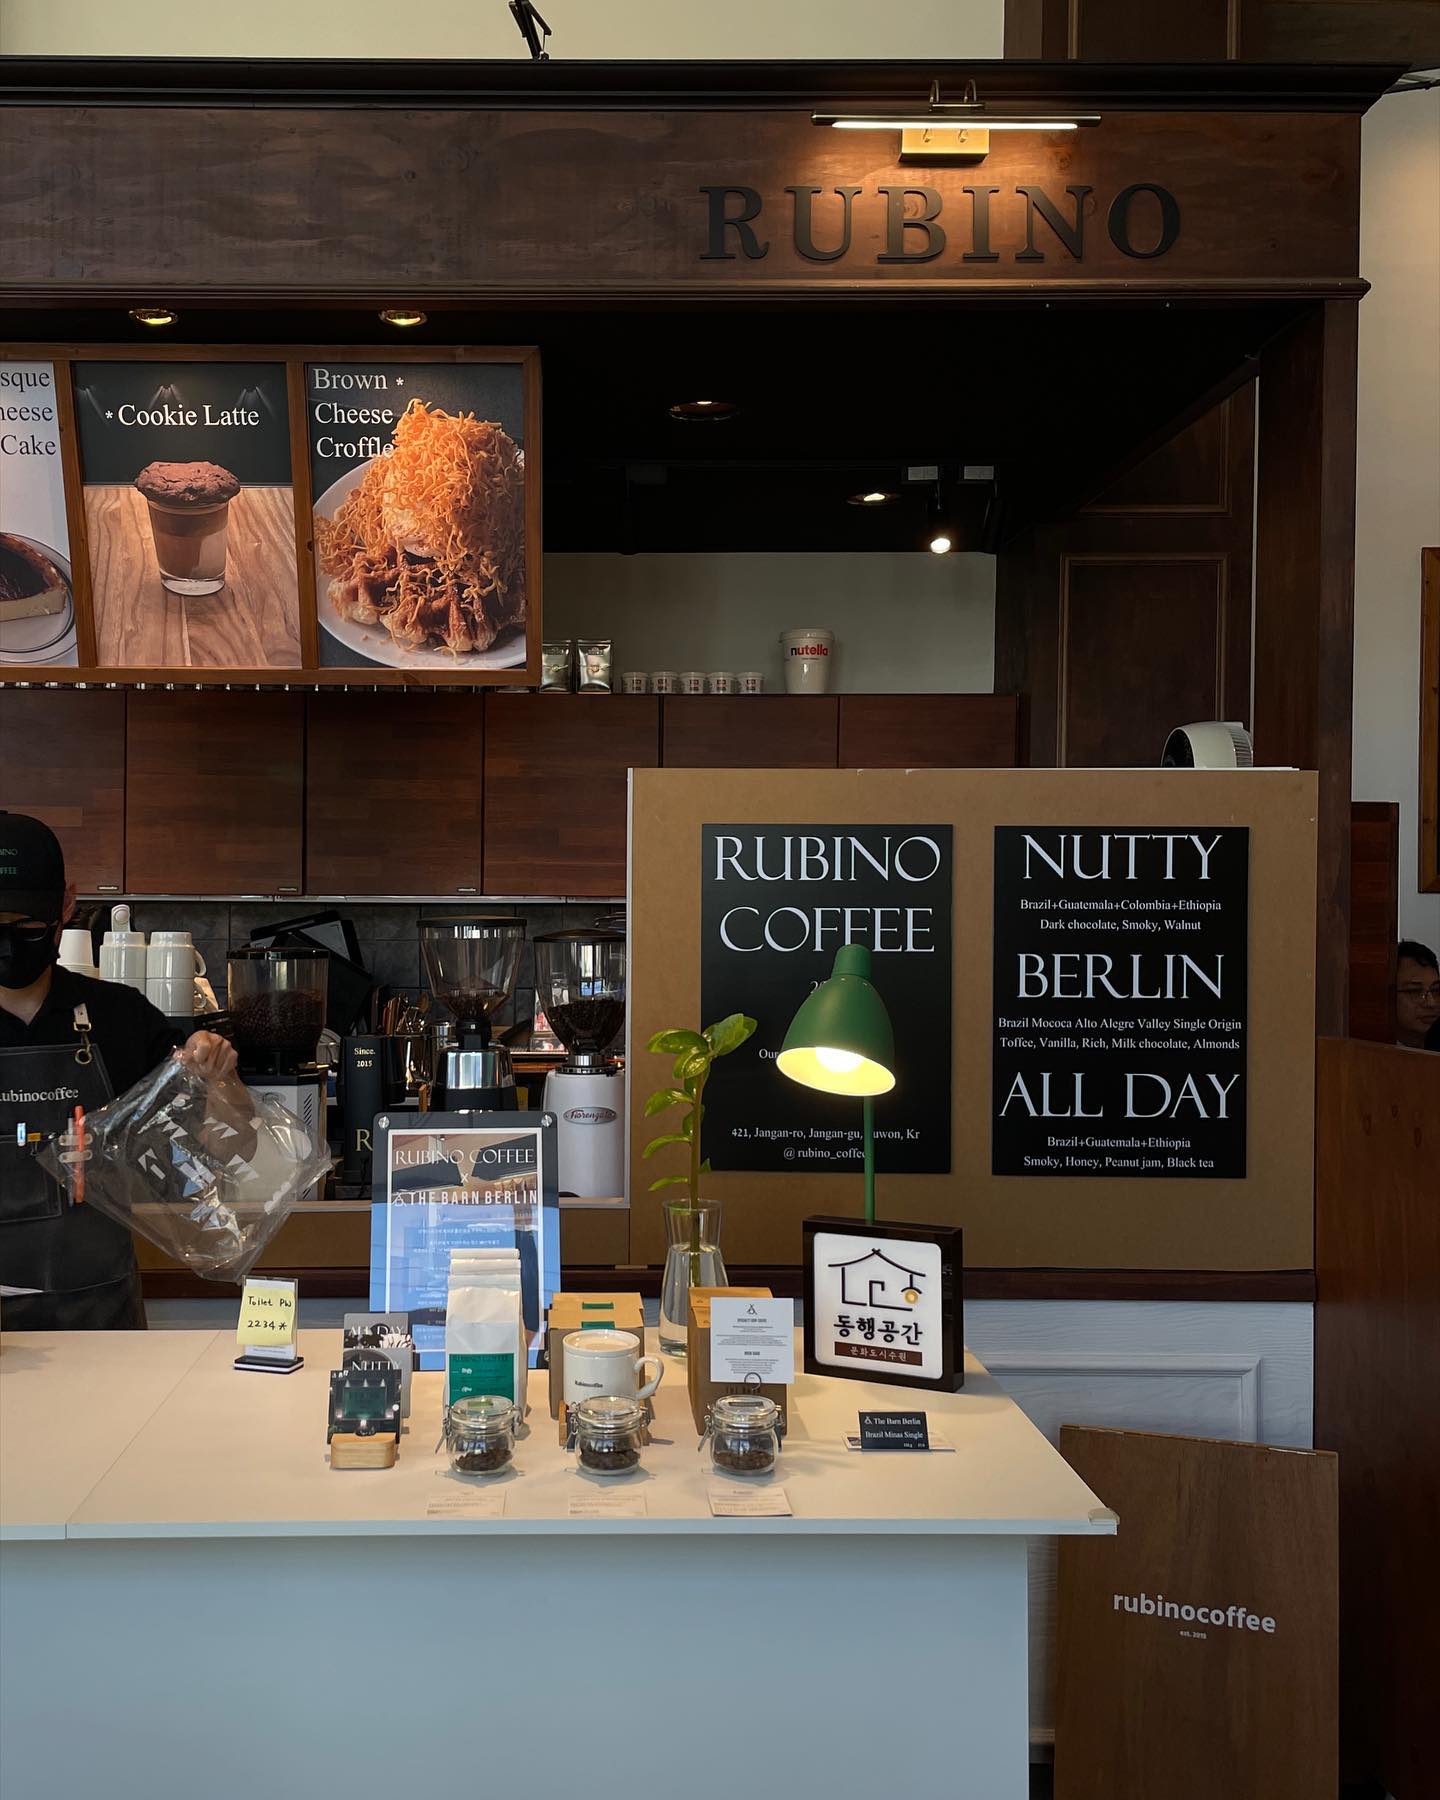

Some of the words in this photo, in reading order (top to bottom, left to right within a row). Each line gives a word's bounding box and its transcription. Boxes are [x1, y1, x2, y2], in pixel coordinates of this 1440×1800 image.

[699, 182, 1181, 263] RUBINO
[0, 370, 50, 393] sque
[313, 368, 388, 389] Brown
[118, 404, 198, 426] Cookie
[203, 405, 260, 426] Latte
[315, 402, 394, 424] Cheese
[1, 435, 57, 455] Cake
[316, 436, 394, 458] Croffle
[790, 643, 829, 656] nutella
[714, 835, 941, 882] RUBINO
[1021, 834, 1223, 880] NUTTY
[1020, 899, 1222, 913] Brazil+Guatemala+Colombia+Ethiopia
[720, 906, 936, 952] COFFEE
[1040, 919, 1065, 930] Dark
[1067, 919, 1119, 931] chocolate,
[1122, 919, 1161, 932] Smoky,
[1164, 919, 1201, 930] Walnut
[1017, 953, 1224, 999] BERLIN
[998, 1017, 1029, 1028] Brazil
[1031, 1017, 1072, 1028] Mococa
[1075, 1018, 1098, 1029] Alto
[1100, 1018, 1135, 1031] Alegre
[1137, 1018, 1171, 1031] Valley
[1173, 1018, 1206, 1031] Single
[1208, 1018, 1242, 1032] Origin
[1000, 1037, 1036, 1049] Toffee,
[1039, 1037, 1079, 1049] Vanilla,
[1082, 1038, 1109, 1050] Rich,
[1111, 1038, 1136, 1049] Milk
[1138, 1038, 1191, 1050] chocolate,
[1193, 1038, 1240, 1050] Almonds
[356, 1060, 373, 1068] 2015
[999, 1072, 1103, 1118] ALL
[1123, 1073, 1240, 1119] DAY
[732, 1129, 751, 1139] 421,
[754, 1127, 806, 1139] Jangan-ro,
[809, 1128, 863, 1139] Jangan-gu,
[873, 1131, 904, 1140] uwon,
[906, 1129, 920, 1139] Kr
[1047, 1136, 1191, 1149] Brazil+Guatemala+Ethiopia
[395, 1149, 464, 1165] RUBINO
[469, 1149, 535, 1165] COFFEE
[784, 1147, 796, 1160] @
[1023, 1156, 1063, 1168] Smoky,
[1065, 1156, 1102, 1168] Honey,
[1105, 1156, 1139, 1168] Peanut
[1141, 1156, 1164, 1169] jam,
[1167, 1157, 1196, 1168] Black
[1199, 1158, 1214, 1168] tea
[409, 1191, 435, 1205] THE
[441, 1191, 480, 1205] BARN
[485, 1190, 538, 1205] BERLIN
[247, 1296, 273, 1307] Toilet
[834, 1315, 923, 1345] 동행공간
[1113, 1593, 1277, 1633] rubinocoffee
